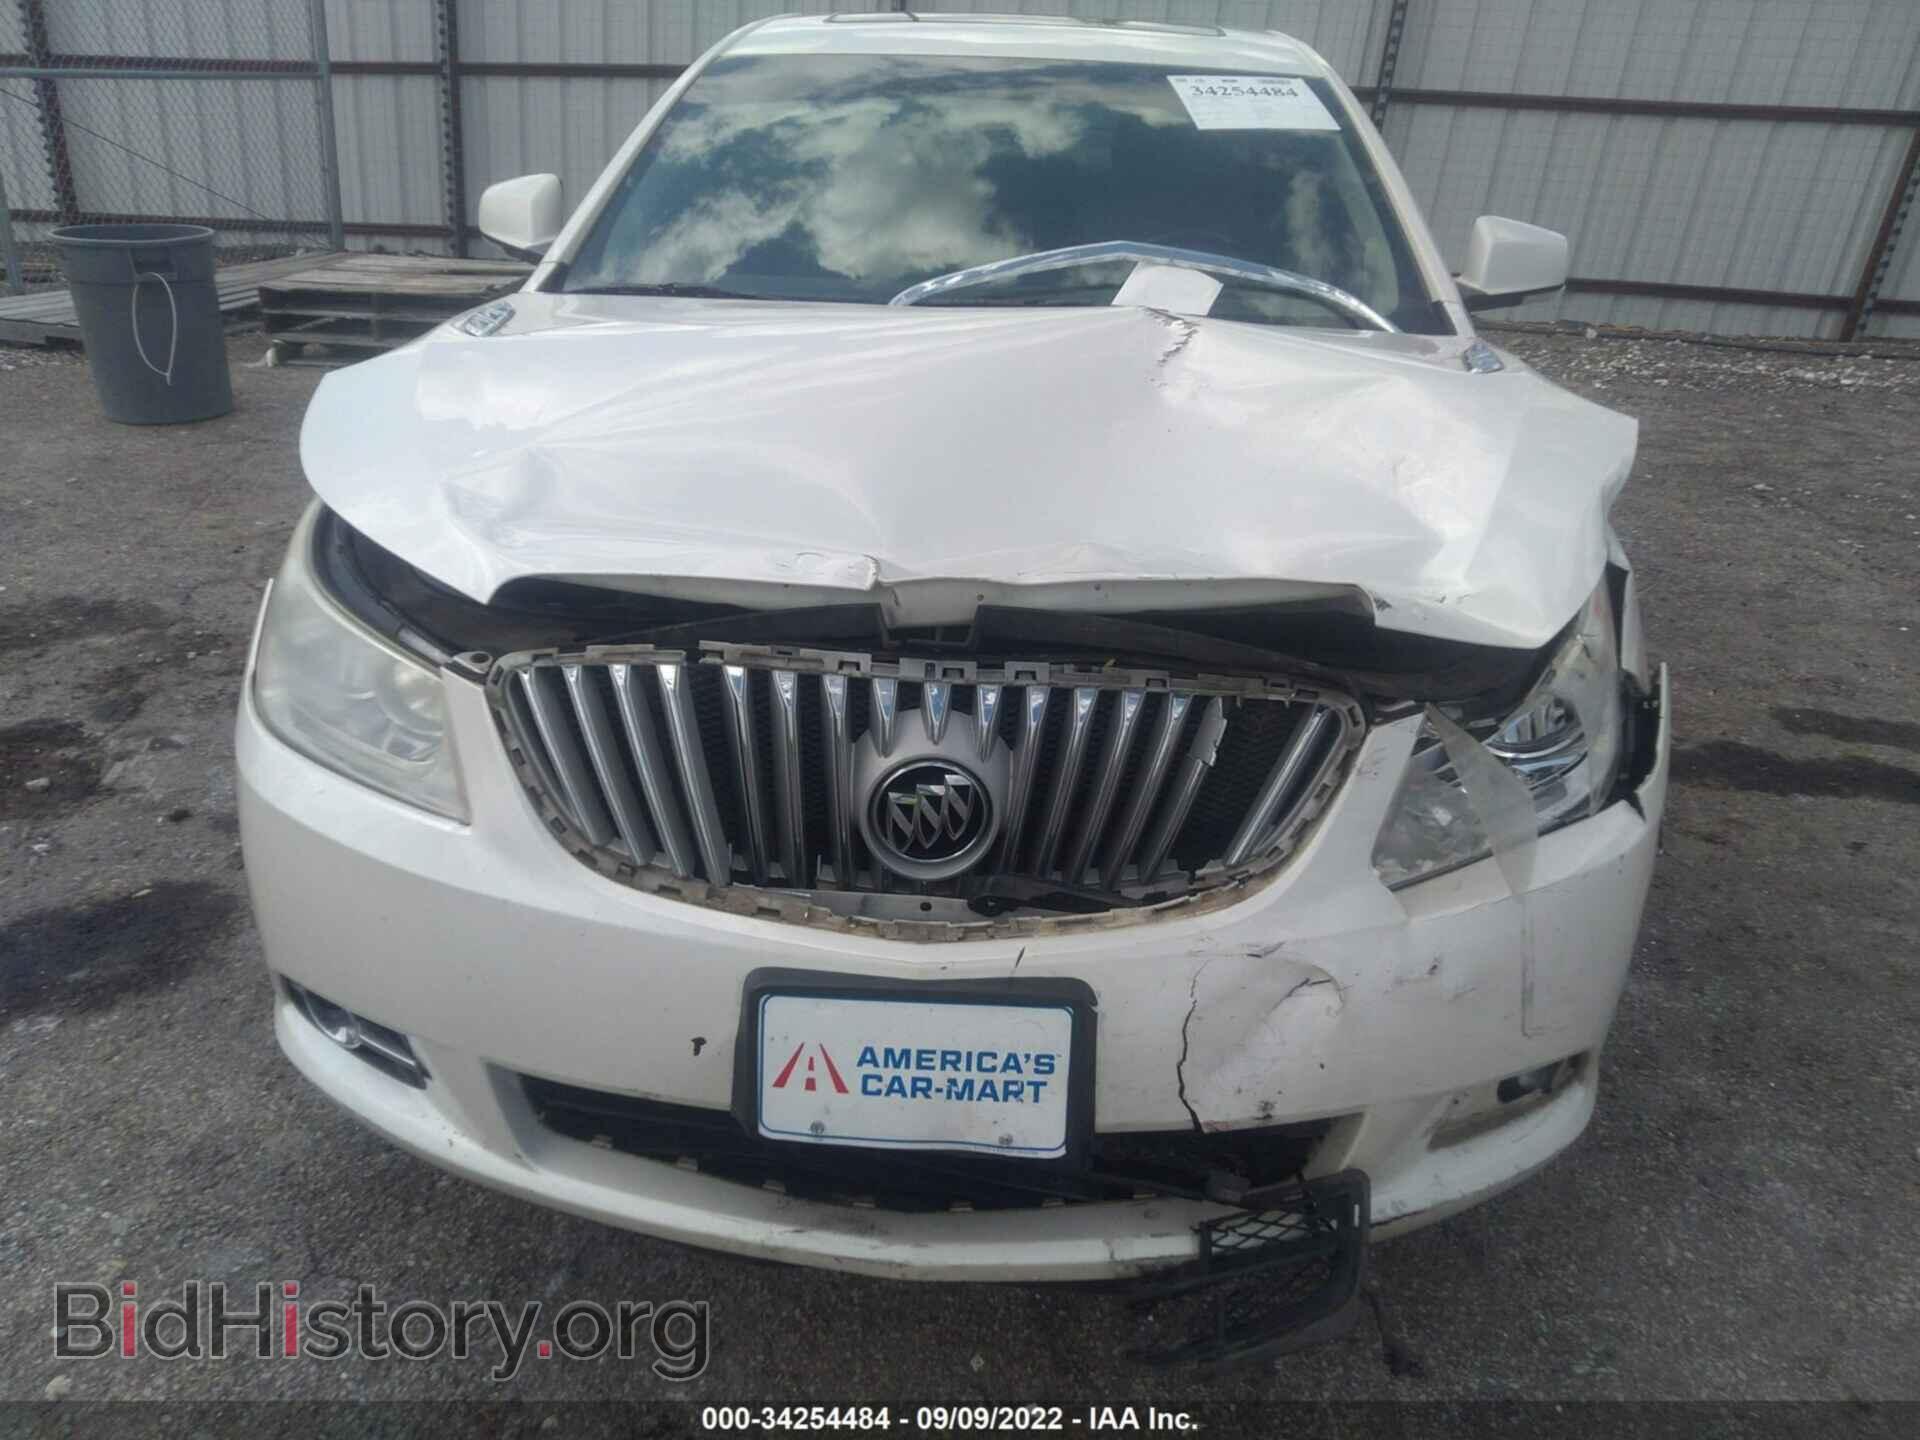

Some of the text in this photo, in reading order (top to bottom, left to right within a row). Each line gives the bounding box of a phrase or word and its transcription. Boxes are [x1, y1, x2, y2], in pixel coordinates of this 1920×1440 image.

[1190, 85, 1299, 97] 34254484
[857, 1046, 1055, 1075] AMERICA'S
[861, 1074, 1047, 1103] CAR-MART
